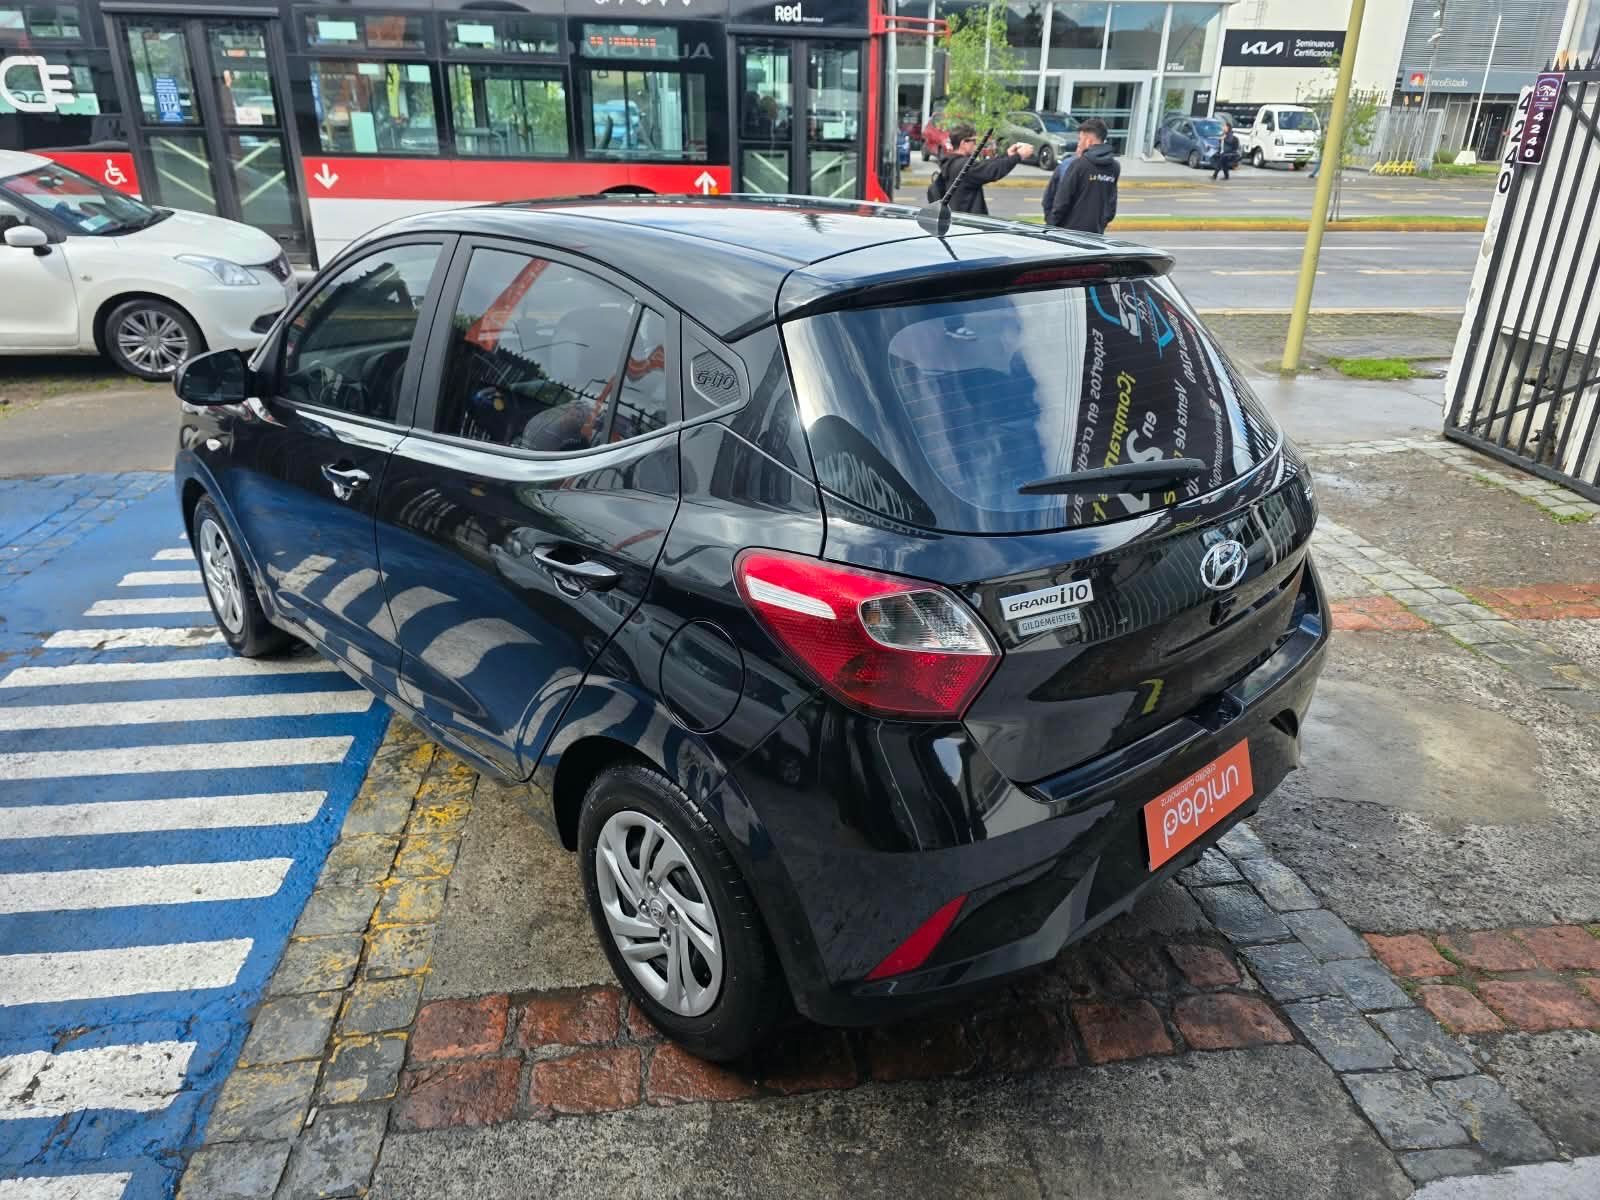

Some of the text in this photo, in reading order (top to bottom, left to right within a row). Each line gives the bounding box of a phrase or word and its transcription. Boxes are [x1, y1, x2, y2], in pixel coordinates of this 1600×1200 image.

[775, 2, 802, 22] Red
[1241, 41, 1284, 55] KIA
[1294, 49, 1333, 57] Certificados
[1296, 39, 1335, 48] Seminuevos
[1524, 112, 1545, 158] 4240
[1008, 584, 1089, 613] GRAND i10
[1021, 610, 1079, 632] GILDEMEISTER
[1162, 764, 1240, 849] unidad
